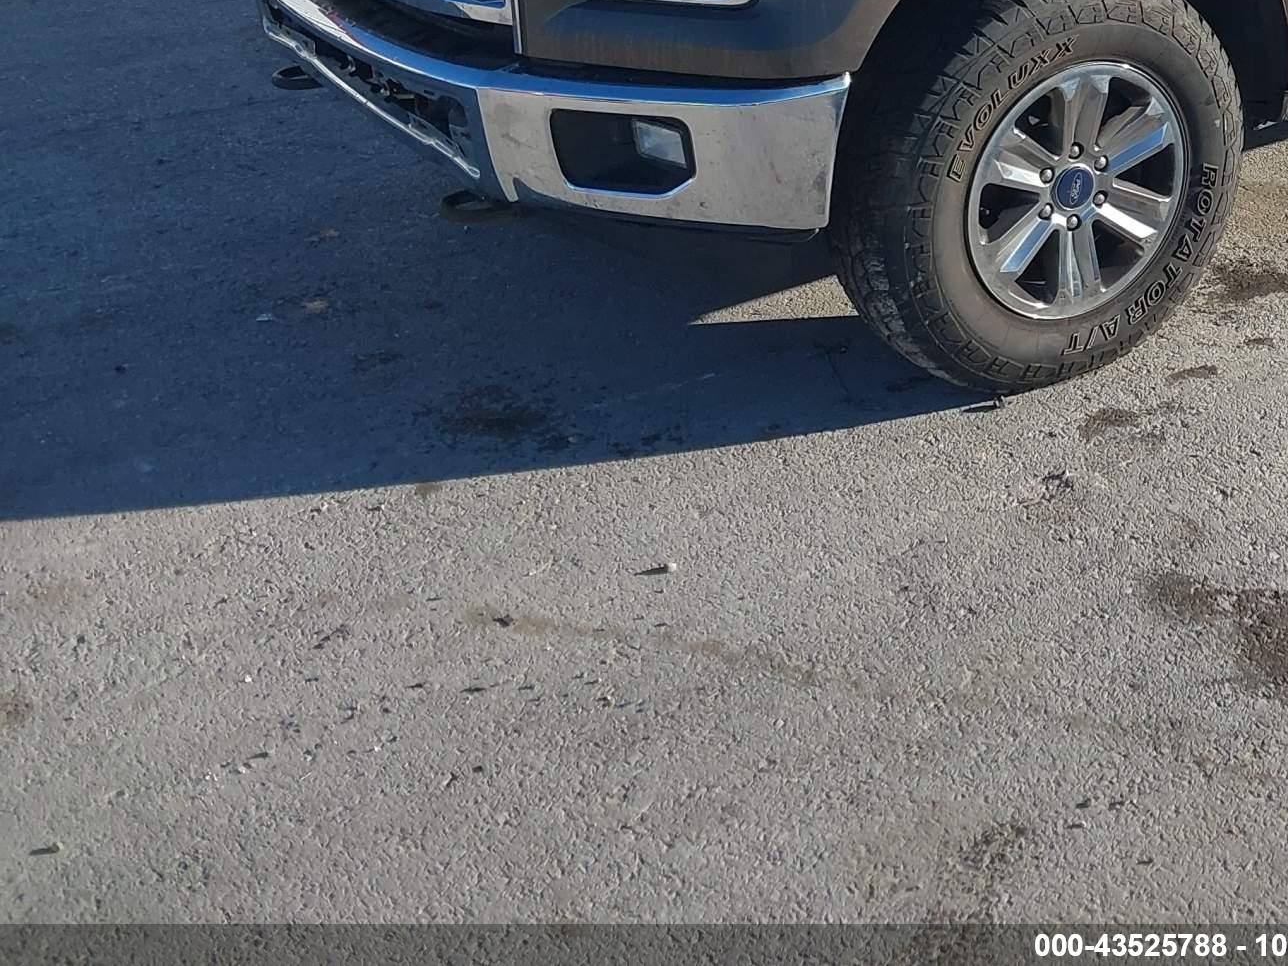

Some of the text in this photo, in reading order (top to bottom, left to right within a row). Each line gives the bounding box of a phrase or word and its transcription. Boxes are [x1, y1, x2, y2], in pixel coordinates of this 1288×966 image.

[947, 35, 1078, 183] EVOLUXX
[1063, 162, 1220, 355] ROTATOR A/T
